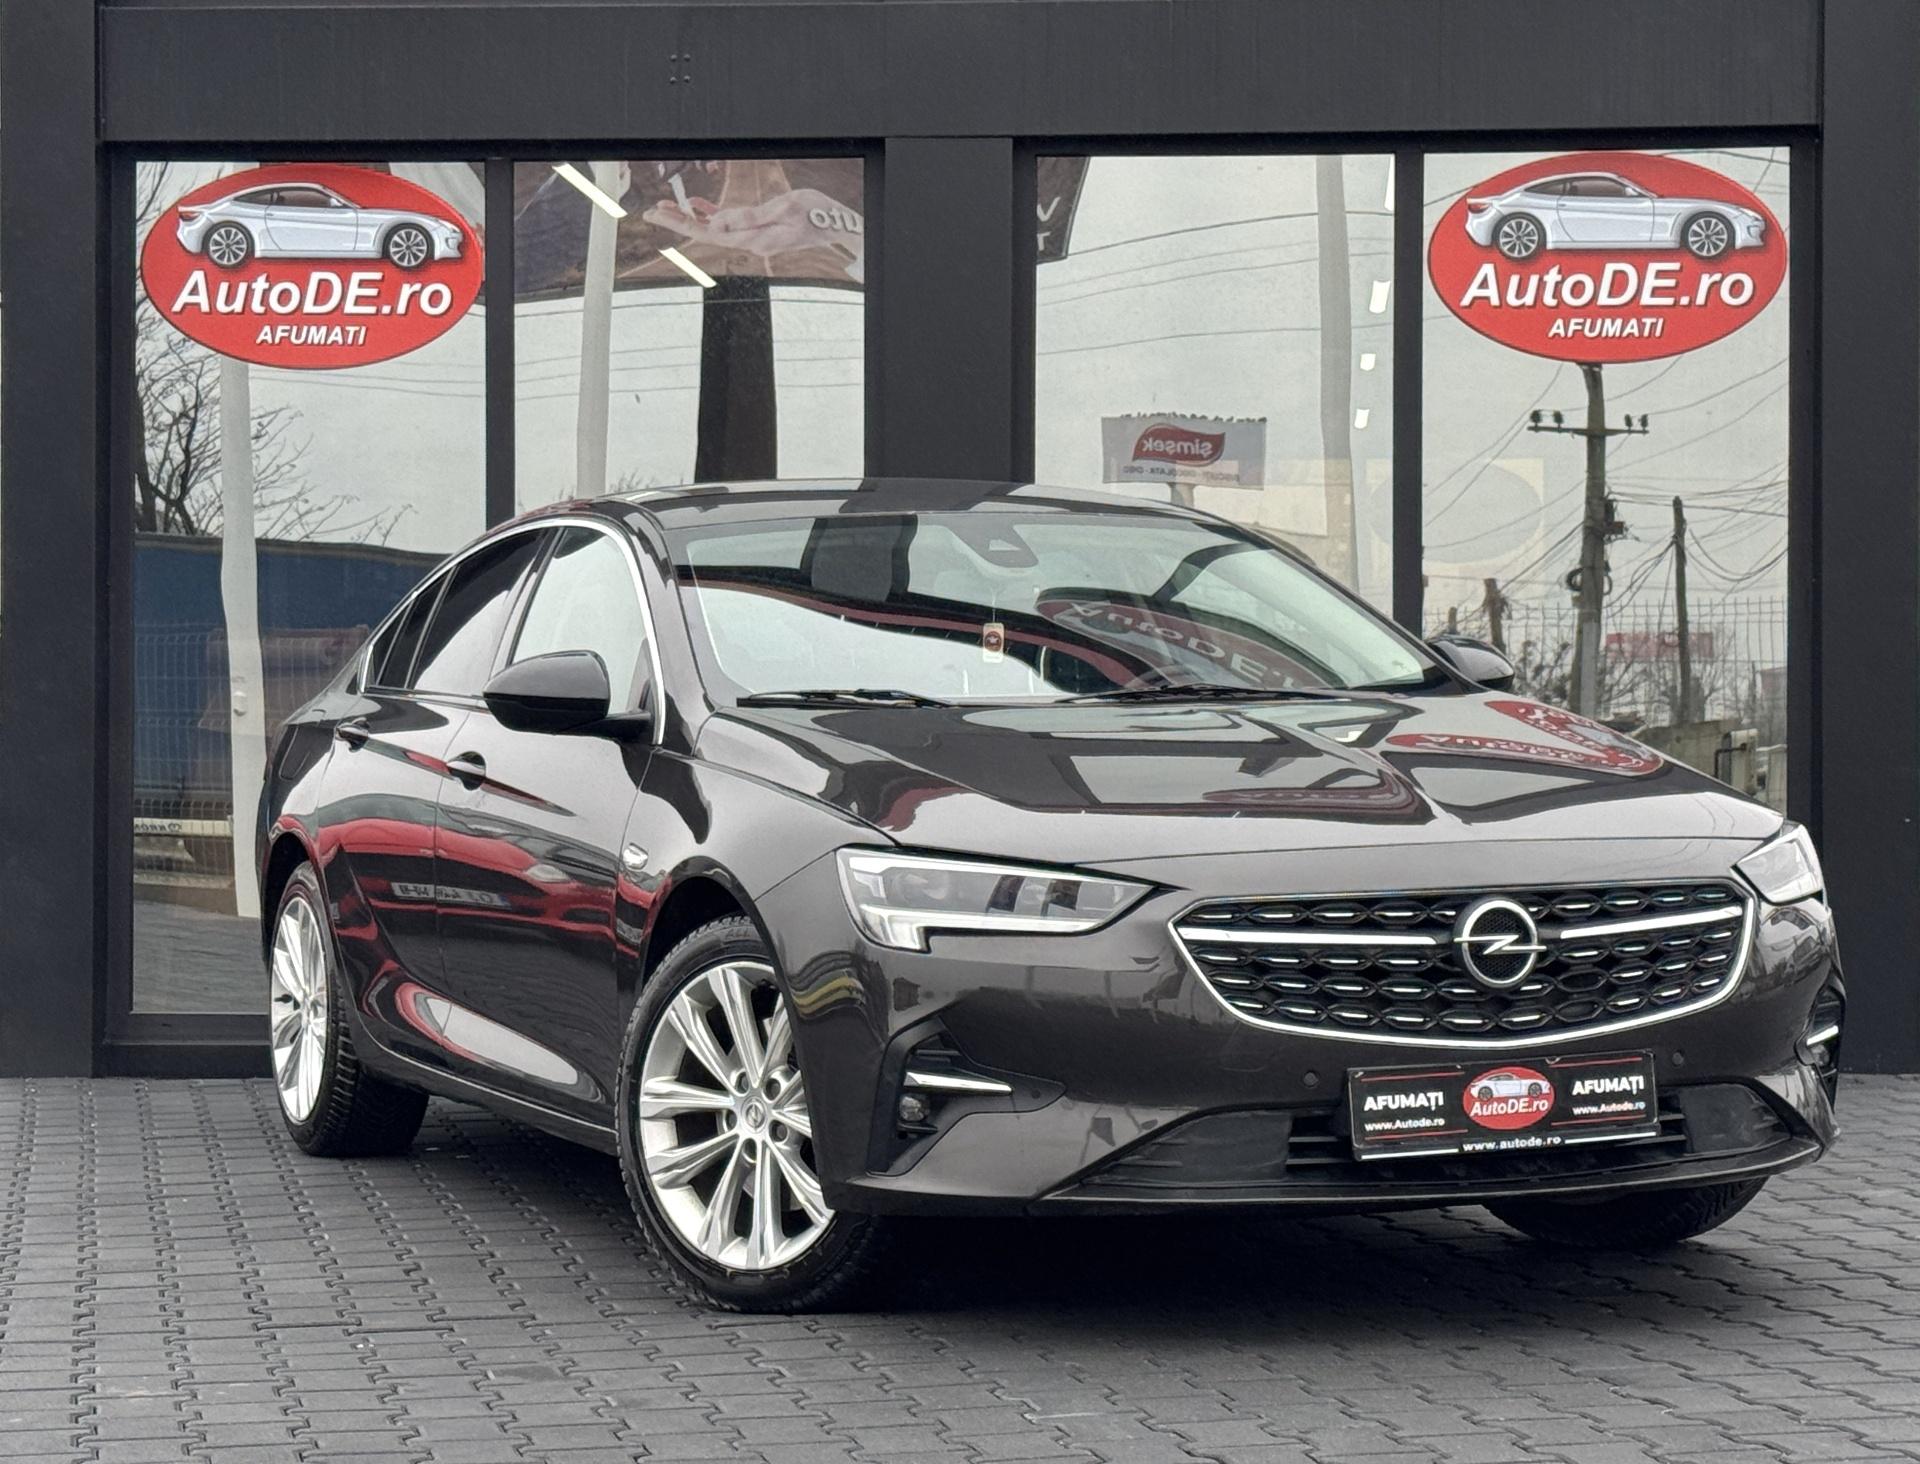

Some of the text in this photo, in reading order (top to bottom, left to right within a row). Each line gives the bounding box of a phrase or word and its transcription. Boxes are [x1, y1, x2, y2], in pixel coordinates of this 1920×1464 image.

[171, 269, 452, 316] AutoDE.ro
[1460, 262, 1754, 307] AutoDE.ro
[256, 325, 367, 346] AFUMATI
[1548, 318, 1665, 338] AFUMATI
[1470, 1098, 1549, 1117] AutoDE.ro
[1572, 1101, 1646, 1116] www.Autode.ro
[1364, 1118, 1445, 1132] www.Autode.ro
[1463, 1136, 1562, 1152] www.autode.ro
